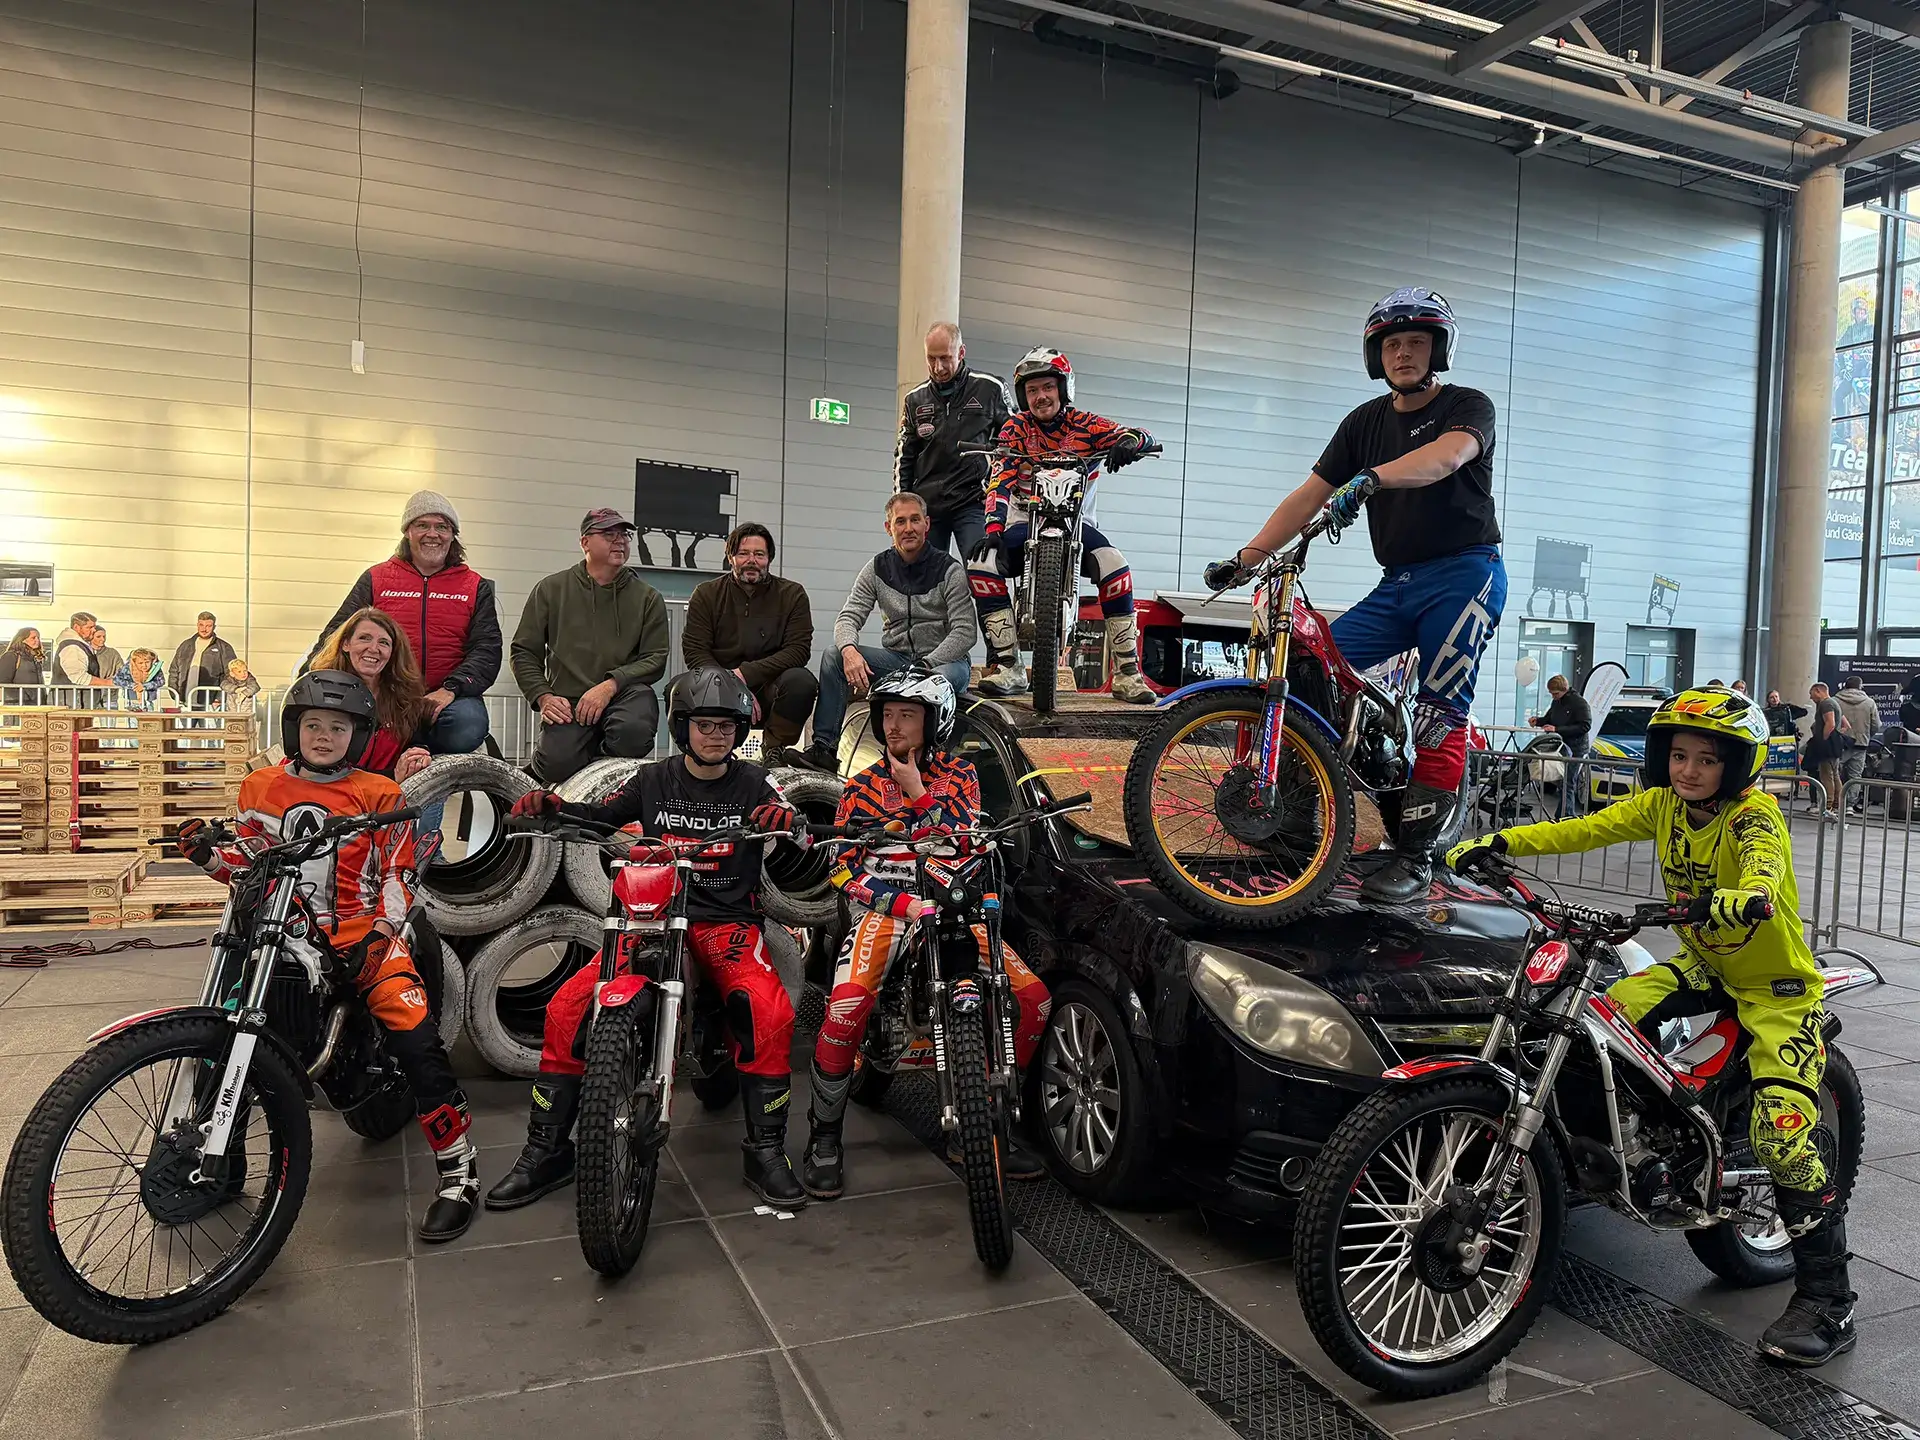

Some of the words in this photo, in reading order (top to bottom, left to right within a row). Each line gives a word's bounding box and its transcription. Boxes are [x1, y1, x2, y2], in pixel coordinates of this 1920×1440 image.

[1830, 443, 1868, 472] Tea
[380, 589, 422, 598] Honda
[428, 591, 469, 602] Racing
[1420, 721, 1445, 748] bonovo
[654, 811, 742, 830] MENDLOR
[1543, 903, 1608, 925] RENTHAL
[857, 912, 885, 976] HONDA
[1530, 950, 1561, 974] 6014
[934, 1023, 945, 1061] BRANTEC
[1002, 1017, 1014, 1052] BRANTEC
[220, 1088, 235, 1108] KM
